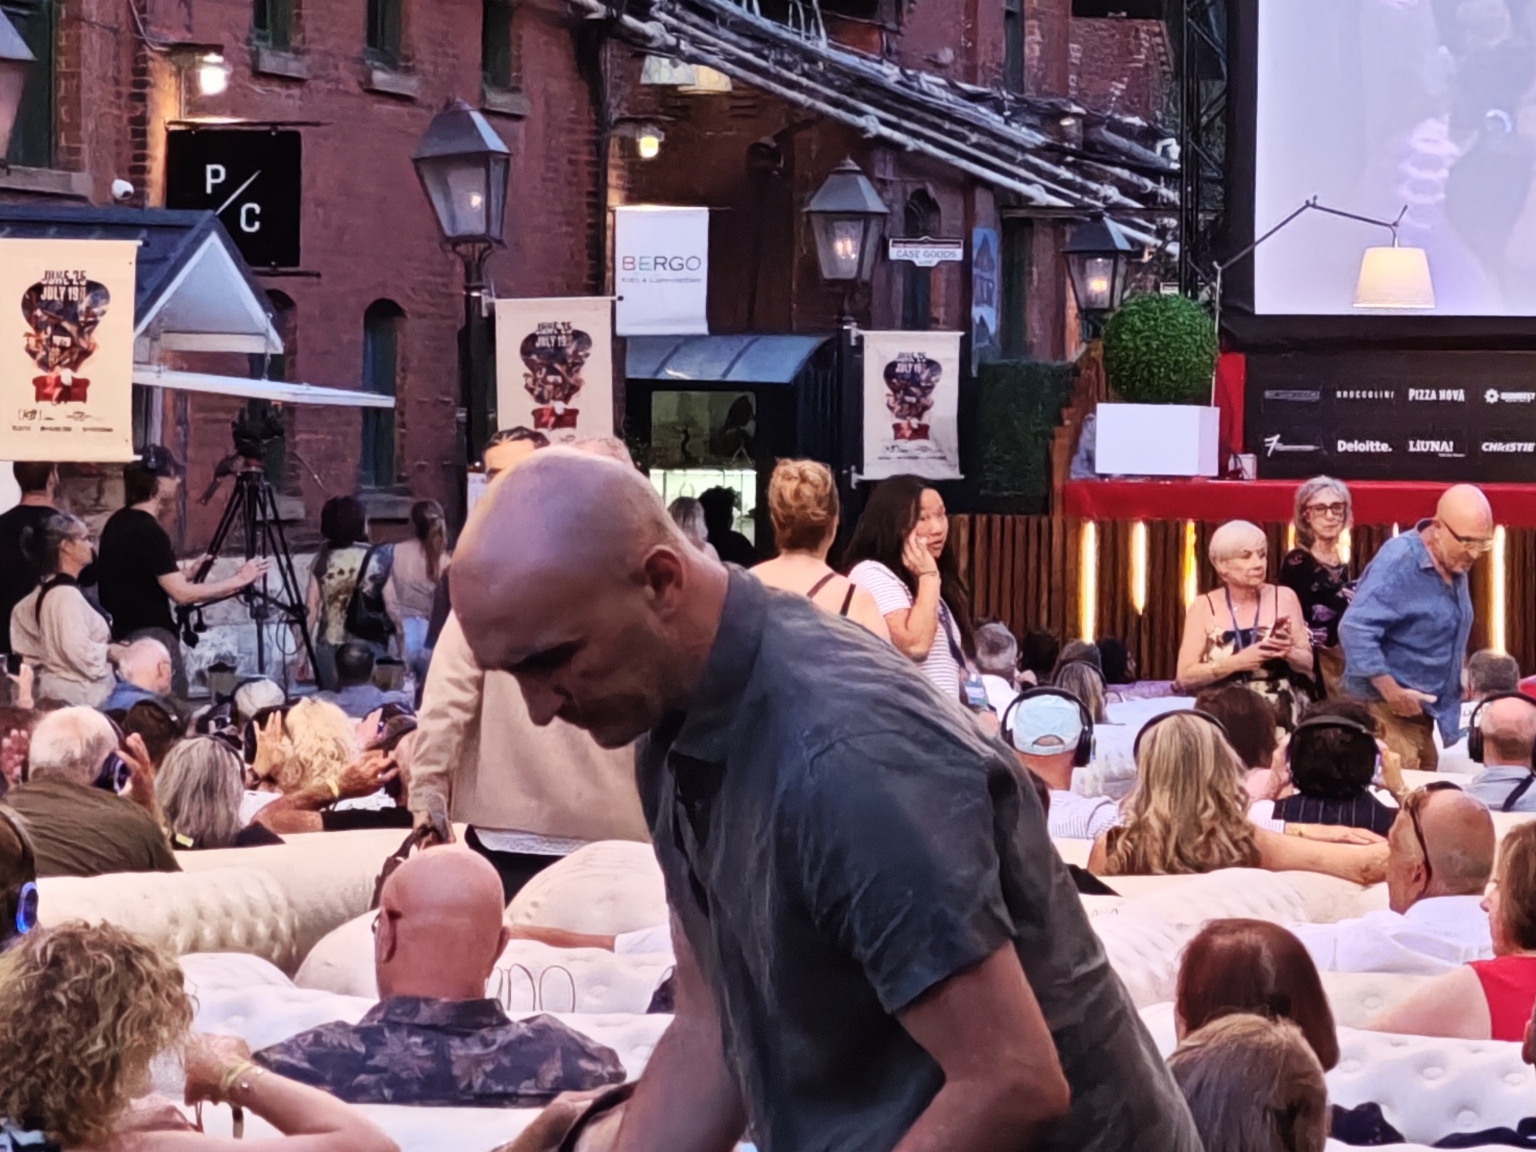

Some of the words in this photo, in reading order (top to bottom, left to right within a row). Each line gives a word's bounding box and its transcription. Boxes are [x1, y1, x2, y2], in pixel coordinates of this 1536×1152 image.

[622, 256, 702, 271] BERGO
[41, 269, 70, 285] JUNE
[40, 285, 66, 301] JULY
[1408, 388, 1437, 401] PIZZA
[1439, 389, 1465, 402] NOVA
[1337, 440, 1393, 452] Deloitte.
